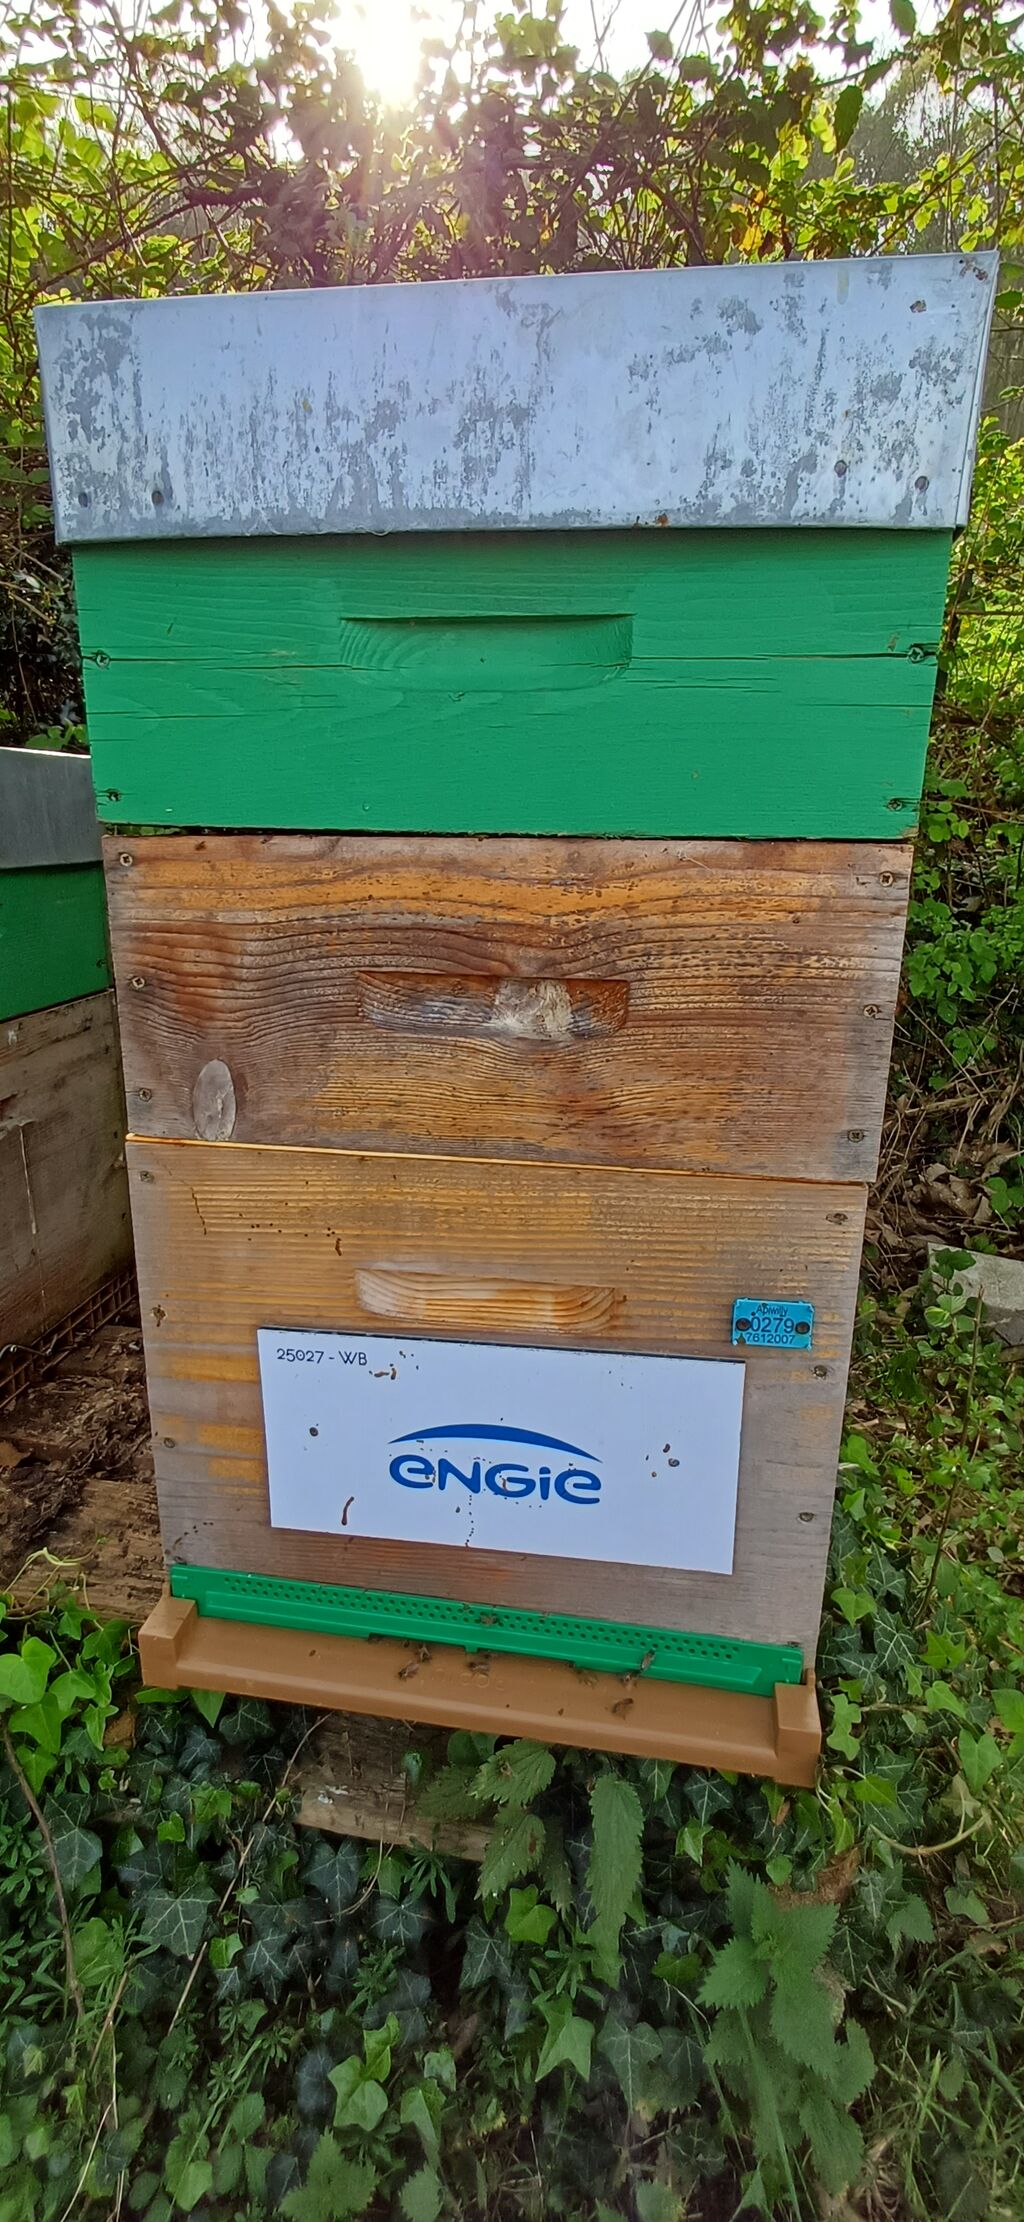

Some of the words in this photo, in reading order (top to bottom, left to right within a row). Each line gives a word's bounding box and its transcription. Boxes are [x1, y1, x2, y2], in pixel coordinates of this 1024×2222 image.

[750, 1316, 795, 1334] 0279
[745, 1332, 796, 1345] 7612007
[276, 1347, 325, 1364] 25027
[338, 1349, 368, 1366] WB
